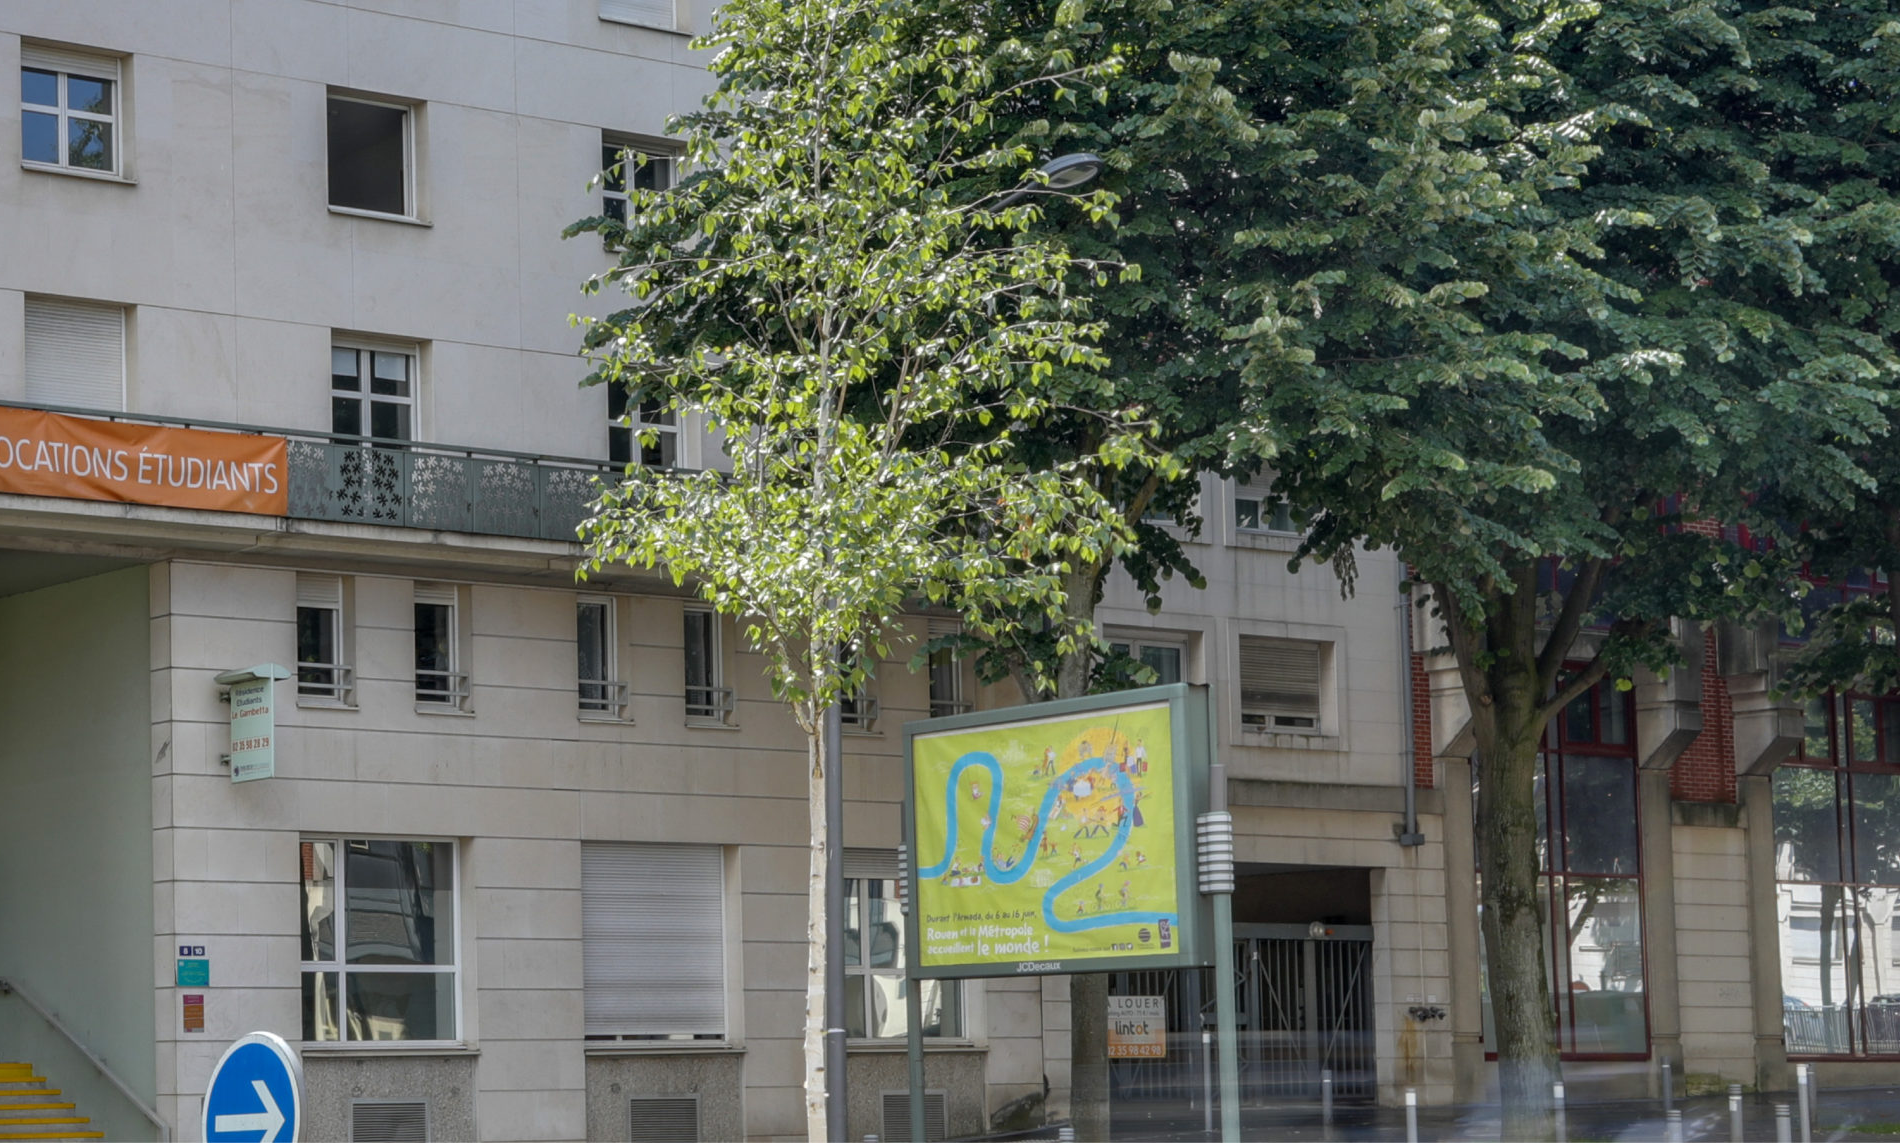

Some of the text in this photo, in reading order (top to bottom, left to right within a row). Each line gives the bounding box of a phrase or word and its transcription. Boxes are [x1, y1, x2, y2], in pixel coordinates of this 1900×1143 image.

[137, 446, 279, 495] ÉTUDIANTS
[236, 696, 263, 707] Etudiants
[231, 706, 269, 720] Le Gambetta
[262, 737, 269, 747] 29
[995, 910, 1000, 920] 6
[1012, 910, 1020, 919] 16
[927, 921, 1033, 941] Rouen et la Métropole
[927, 941, 975, 955] accueillent
[977, 938, 990, 956] le
[994, 936, 1040, 955] monde
[1016, 961, 1061, 973] JCDecaux
[1118, 998, 1159, 1008] LOUER
[1115, 1020, 1149, 1036] lintot
[1117, 1045, 1127, 1056] 35
